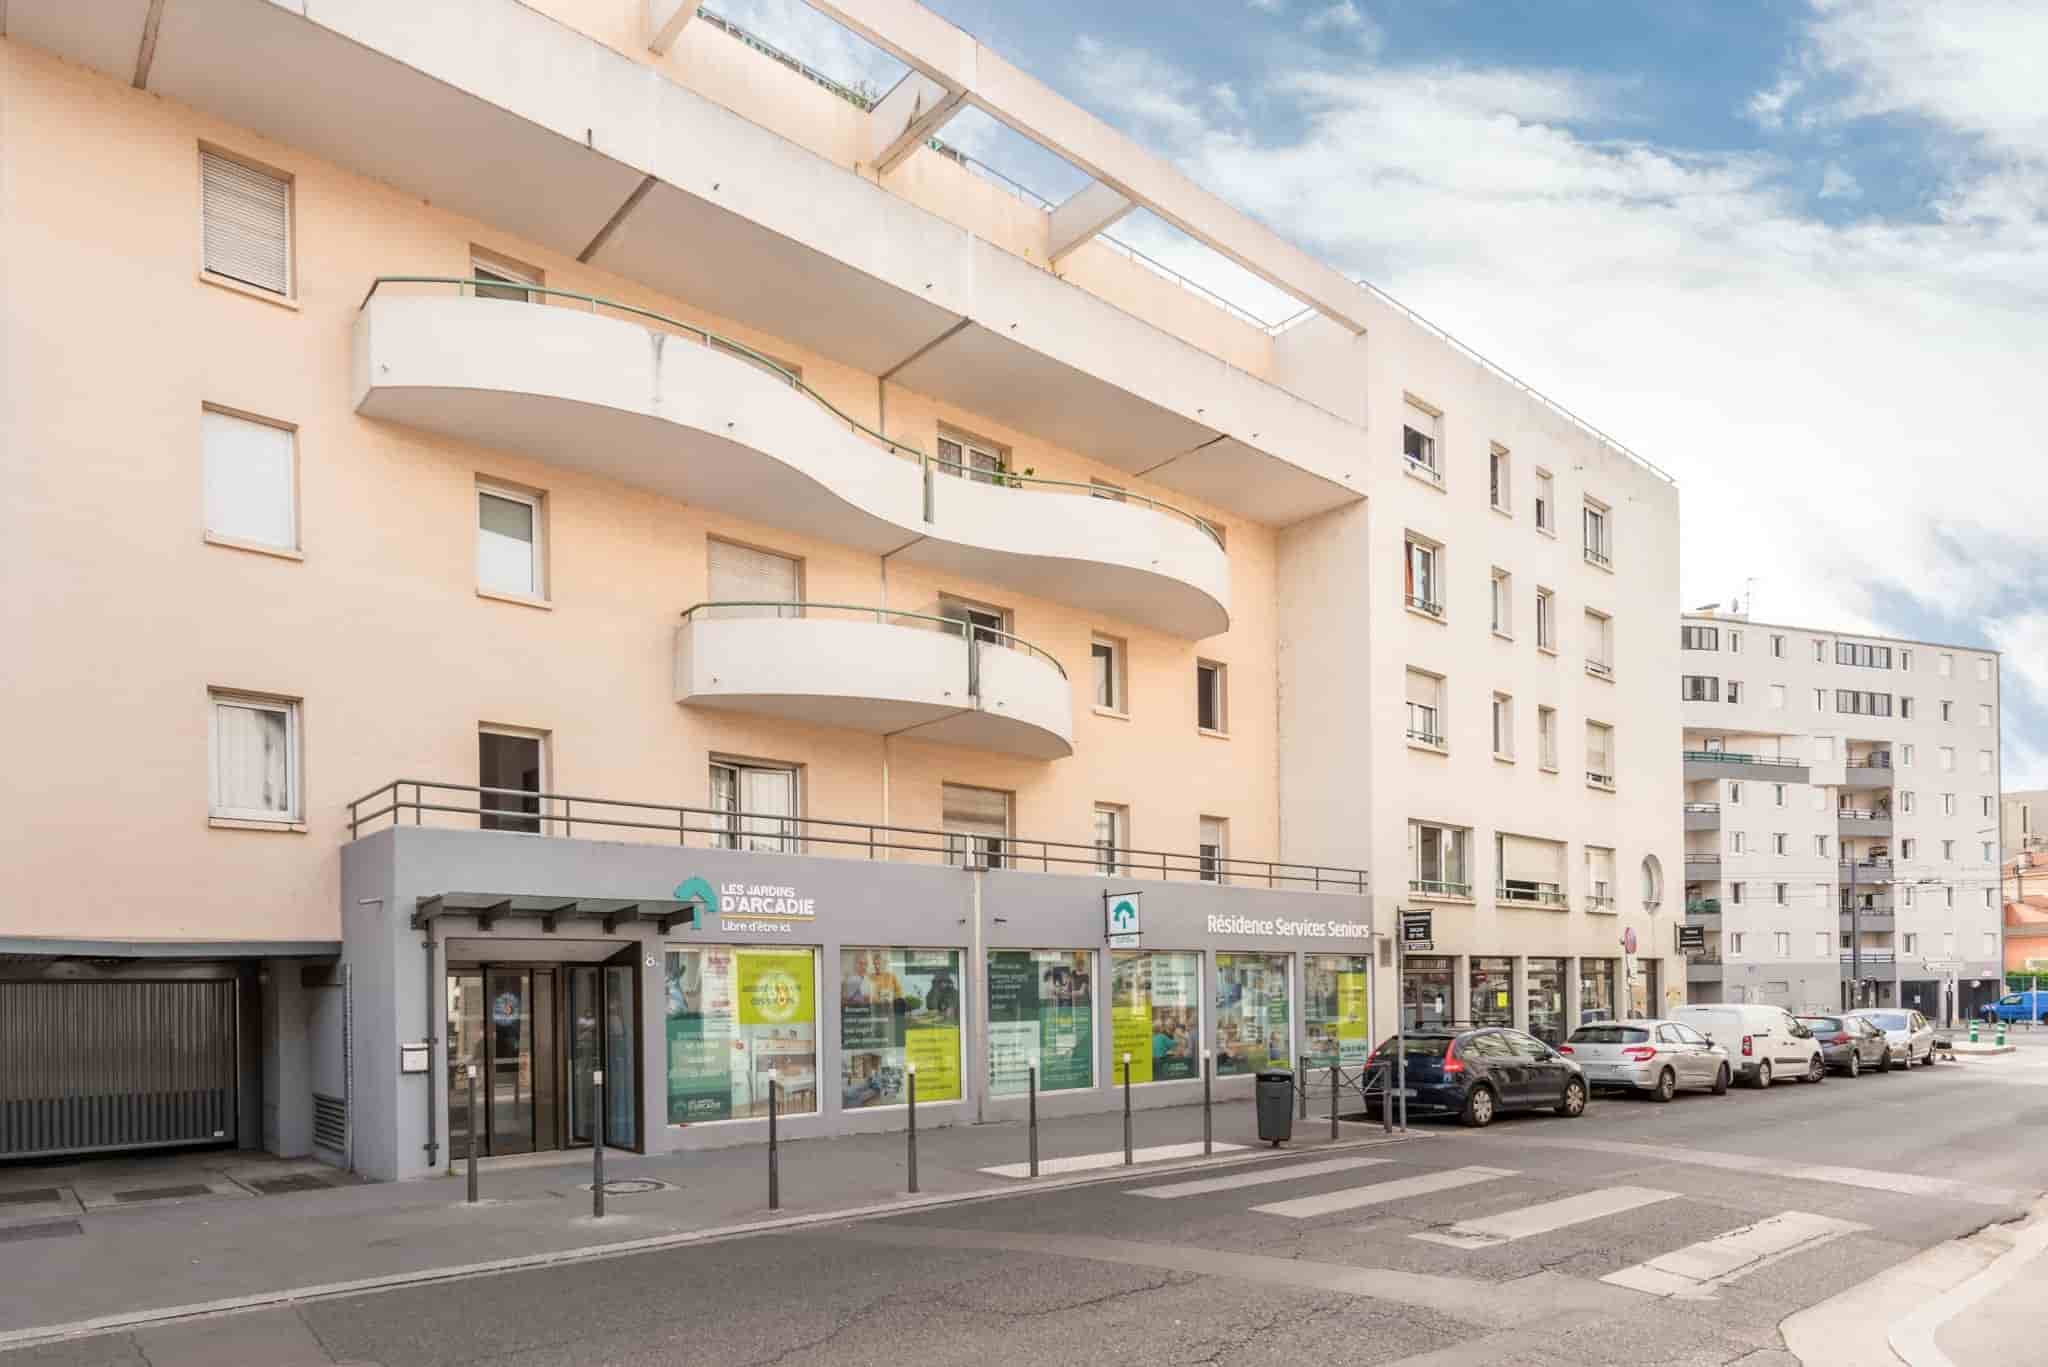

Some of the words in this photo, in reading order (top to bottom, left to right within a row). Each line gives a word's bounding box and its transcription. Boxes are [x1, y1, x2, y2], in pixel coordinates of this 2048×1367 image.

[721, 883, 744, 896] LES
[746, 886, 795, 898] JARDINS
[721, 896, 815, 914] D'ARCADIE
[721, 919, 746, 932] Libre
[1207, 914, 1273, 935] Résidence
[1275, 916, 1326, 937] Services
[1327, 920, 1369, 938] Seniors
